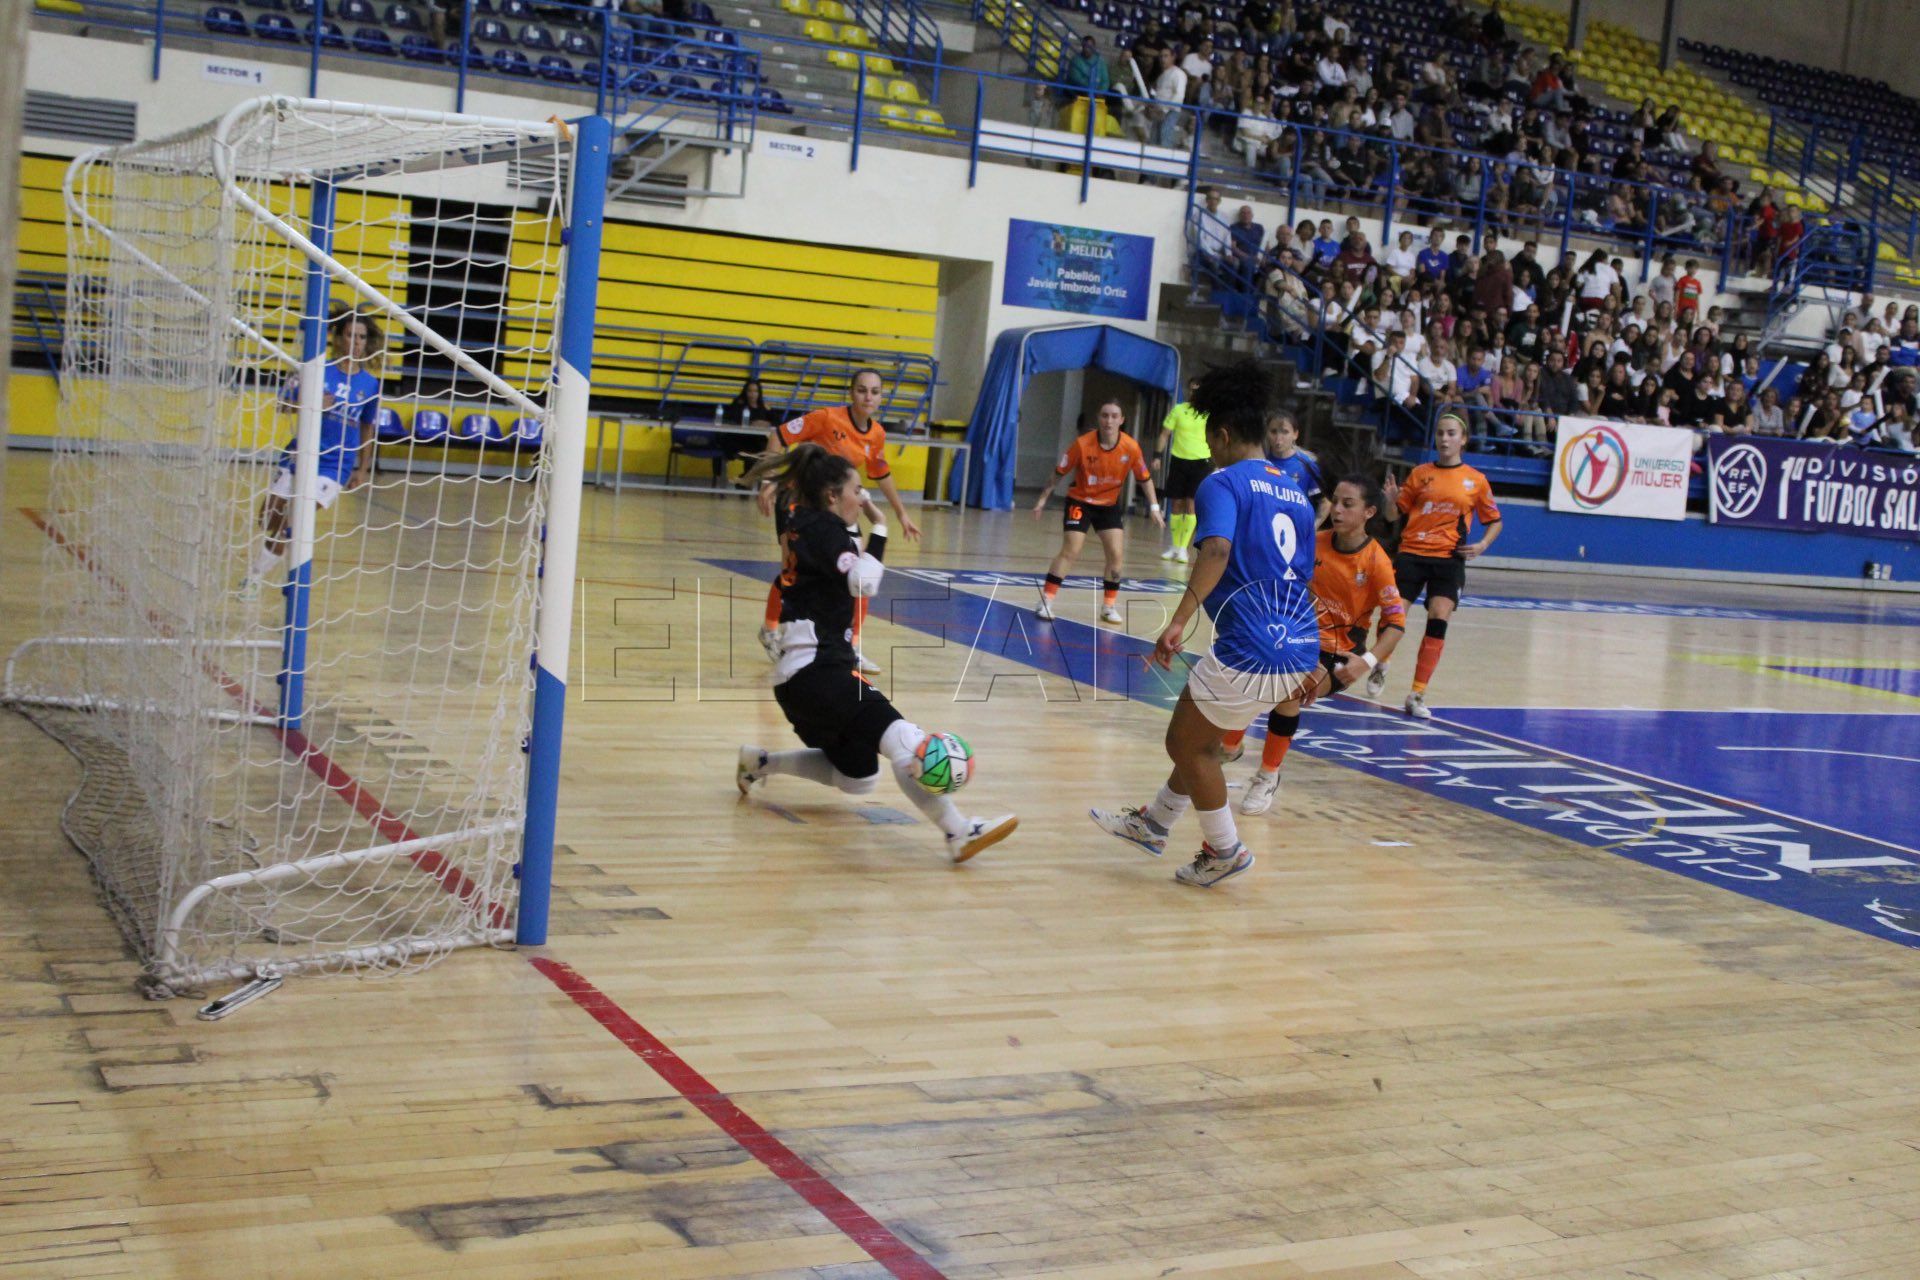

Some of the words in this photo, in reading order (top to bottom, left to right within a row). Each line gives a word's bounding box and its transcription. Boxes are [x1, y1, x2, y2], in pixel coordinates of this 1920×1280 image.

[207, 65, 248, 77] SECTOR
[255, 72, 262, 84] 1
[769, 141, 802, 152] SECTOR
[806, 147, 815, 158] 2
[1069, 243, 1114, 260] MELILLA
[1027, 276, 1058, 290] Javier
[1060, 281, 1102, 296] Imbroda
[1103, 285, 1128, 298] Ortiz
[1634, 456, 1685, 472] UNIVERSO
[1807, 457, 1919, 485] DIVISIÓ
[1631, 471, 1682, 489] MUJER
[1804, 473, 1878, 528] FÚTBOL
[1880, 488, 1920, 531] SAL
